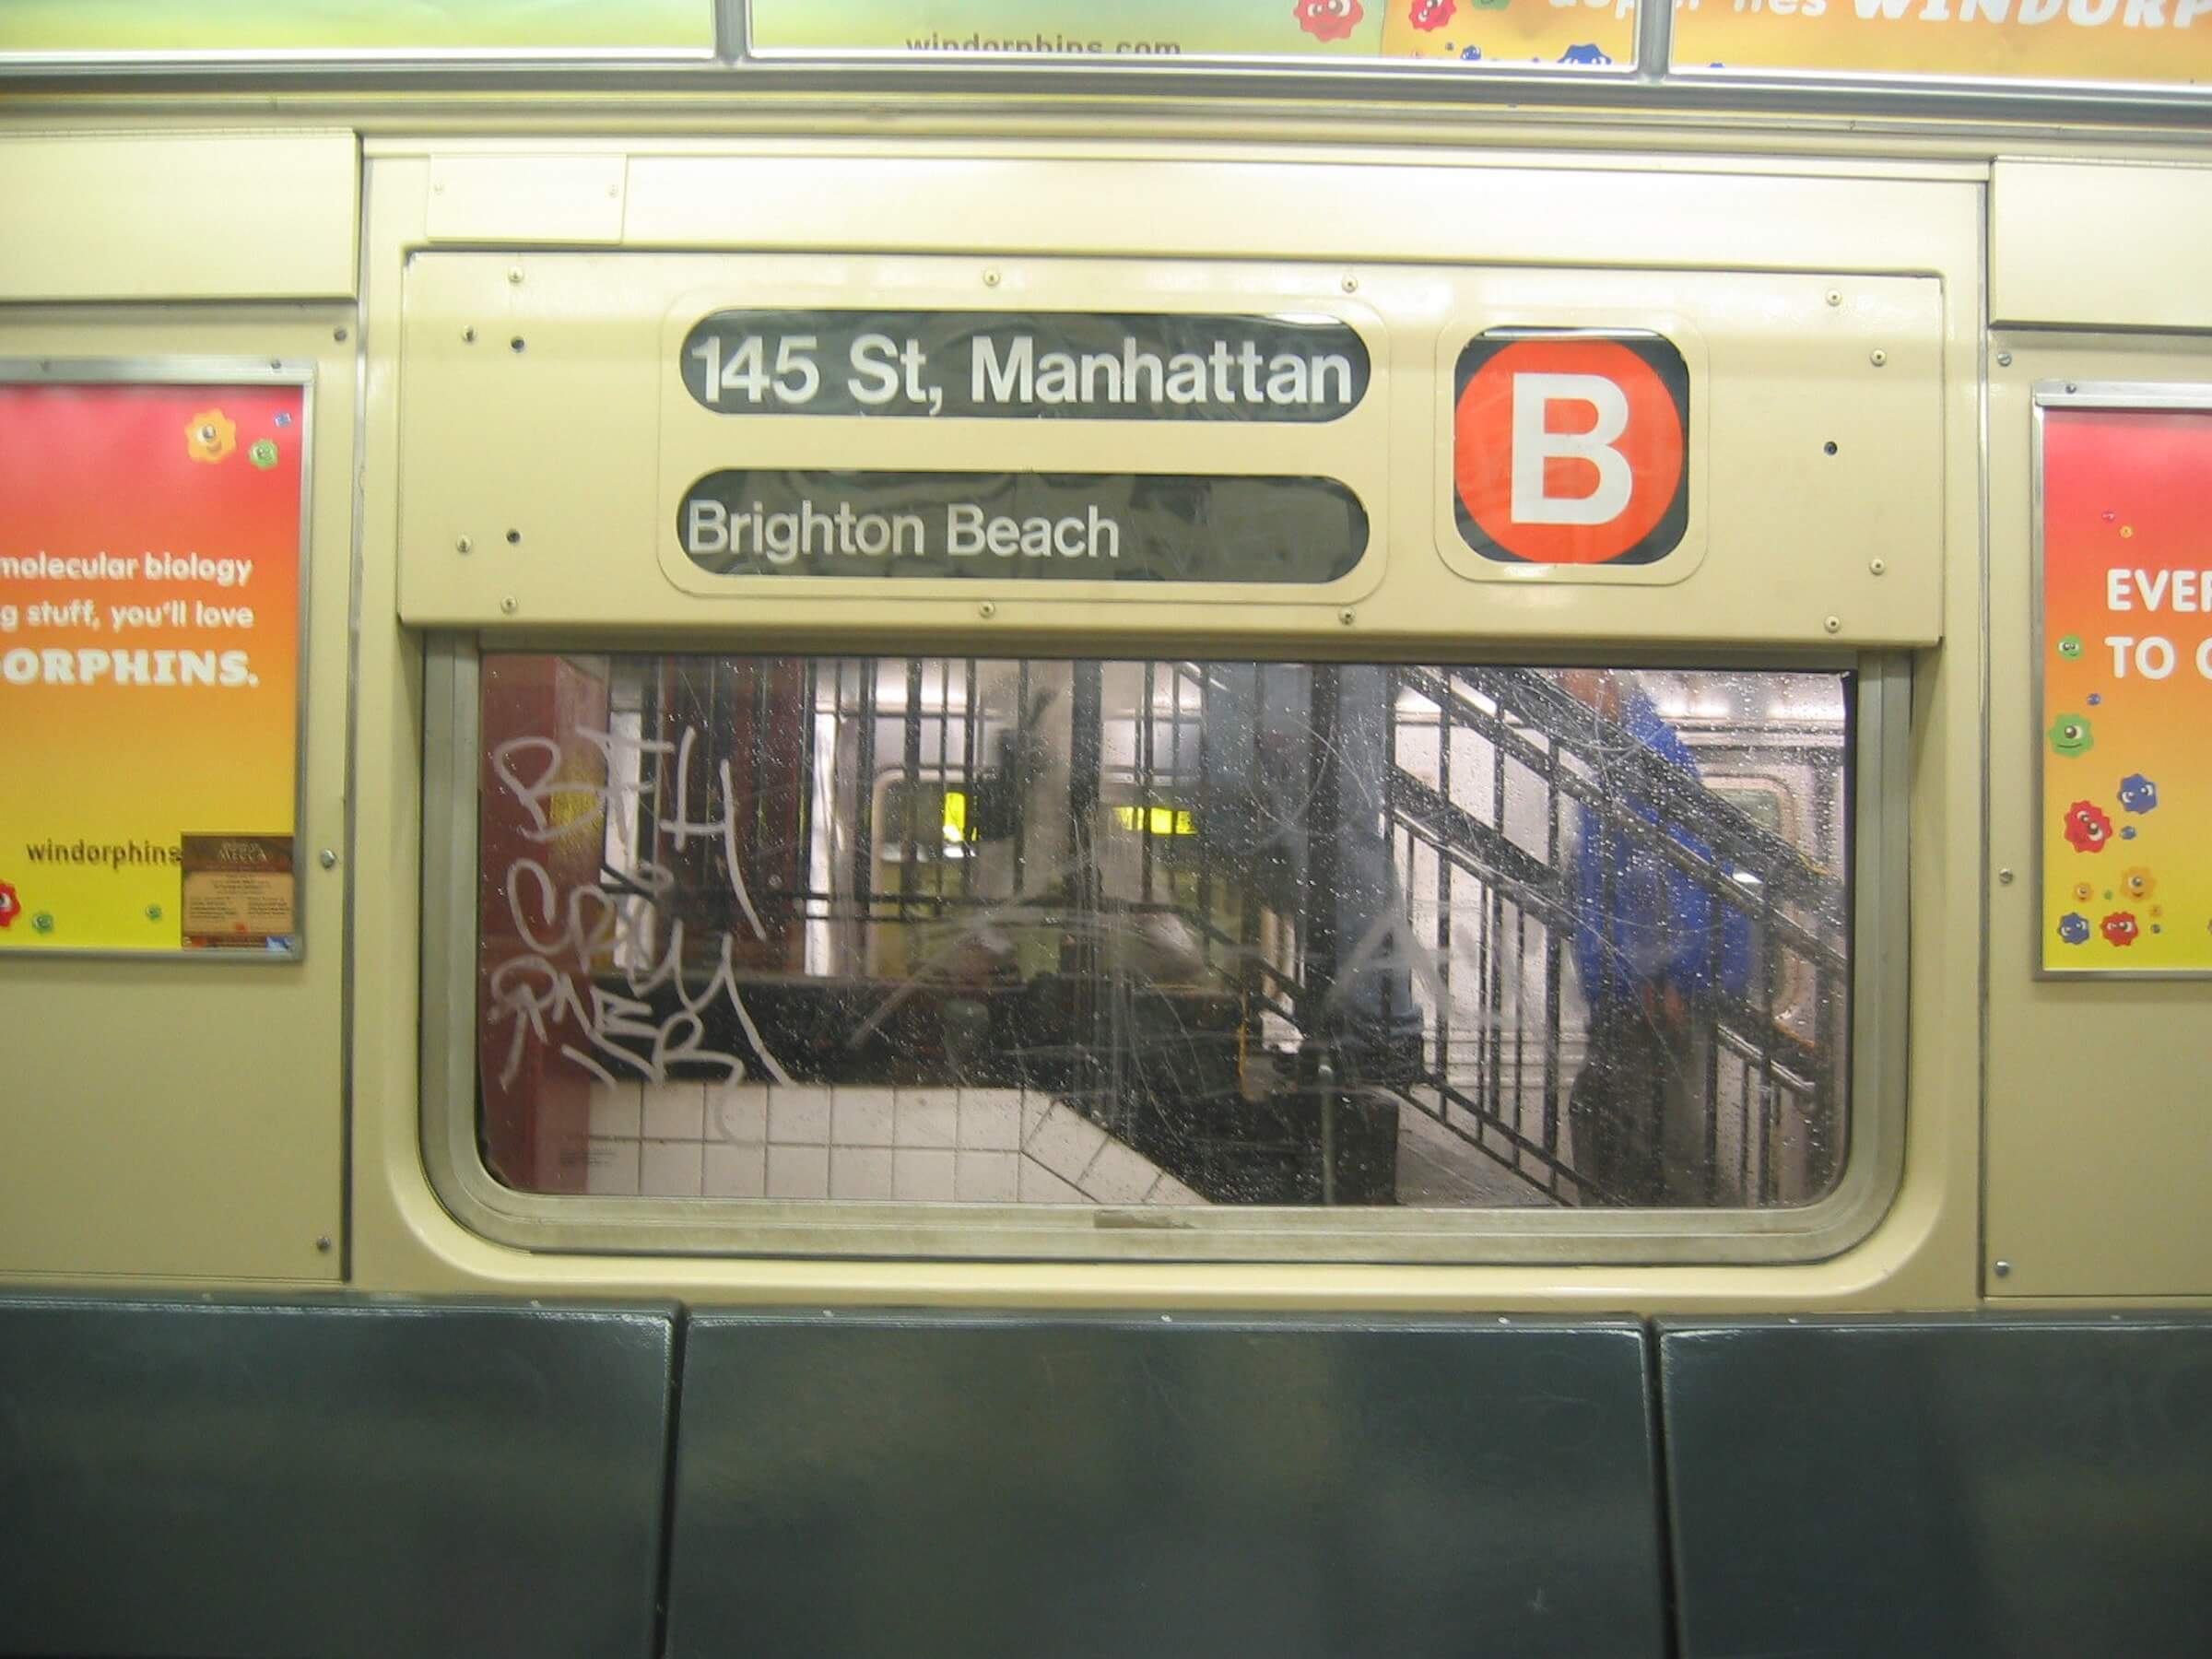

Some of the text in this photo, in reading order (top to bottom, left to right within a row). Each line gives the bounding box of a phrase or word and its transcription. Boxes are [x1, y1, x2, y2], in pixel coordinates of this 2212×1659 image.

[691, 334, 1352, 415] 145 St, Manhattan
[1511, 371, 1632, 524] B
[688, 500, 1119, 564] Brighton Beach
[0, 551, 253, 587] molecular biology
[27, 599, 100, 631] stuff,
[111, 600, 187, 633] you'll
[195, 600, 254, 628] love
[2104, 636, 2175, 679] TO
